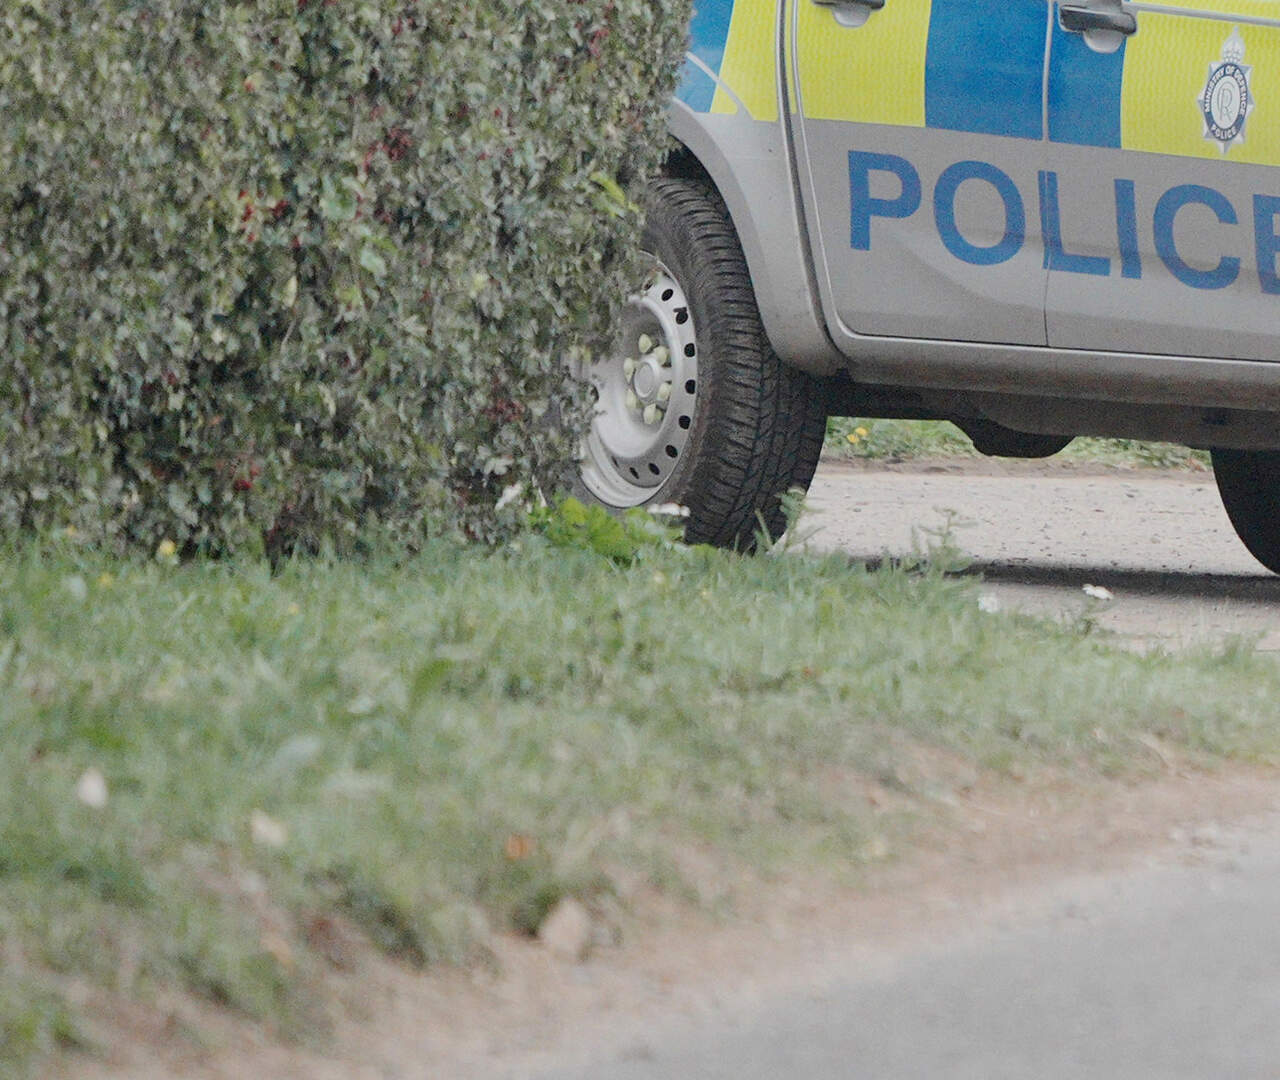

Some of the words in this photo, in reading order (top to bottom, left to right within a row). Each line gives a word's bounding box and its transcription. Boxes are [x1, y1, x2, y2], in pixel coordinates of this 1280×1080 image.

[1204, 66, 1225, 113] MINISTRY
[1225, 65, 1235, 75] OF
[1233, 68, 1247, 116] DEFENCE
[1210, 123, 1237, 140] POLICE
